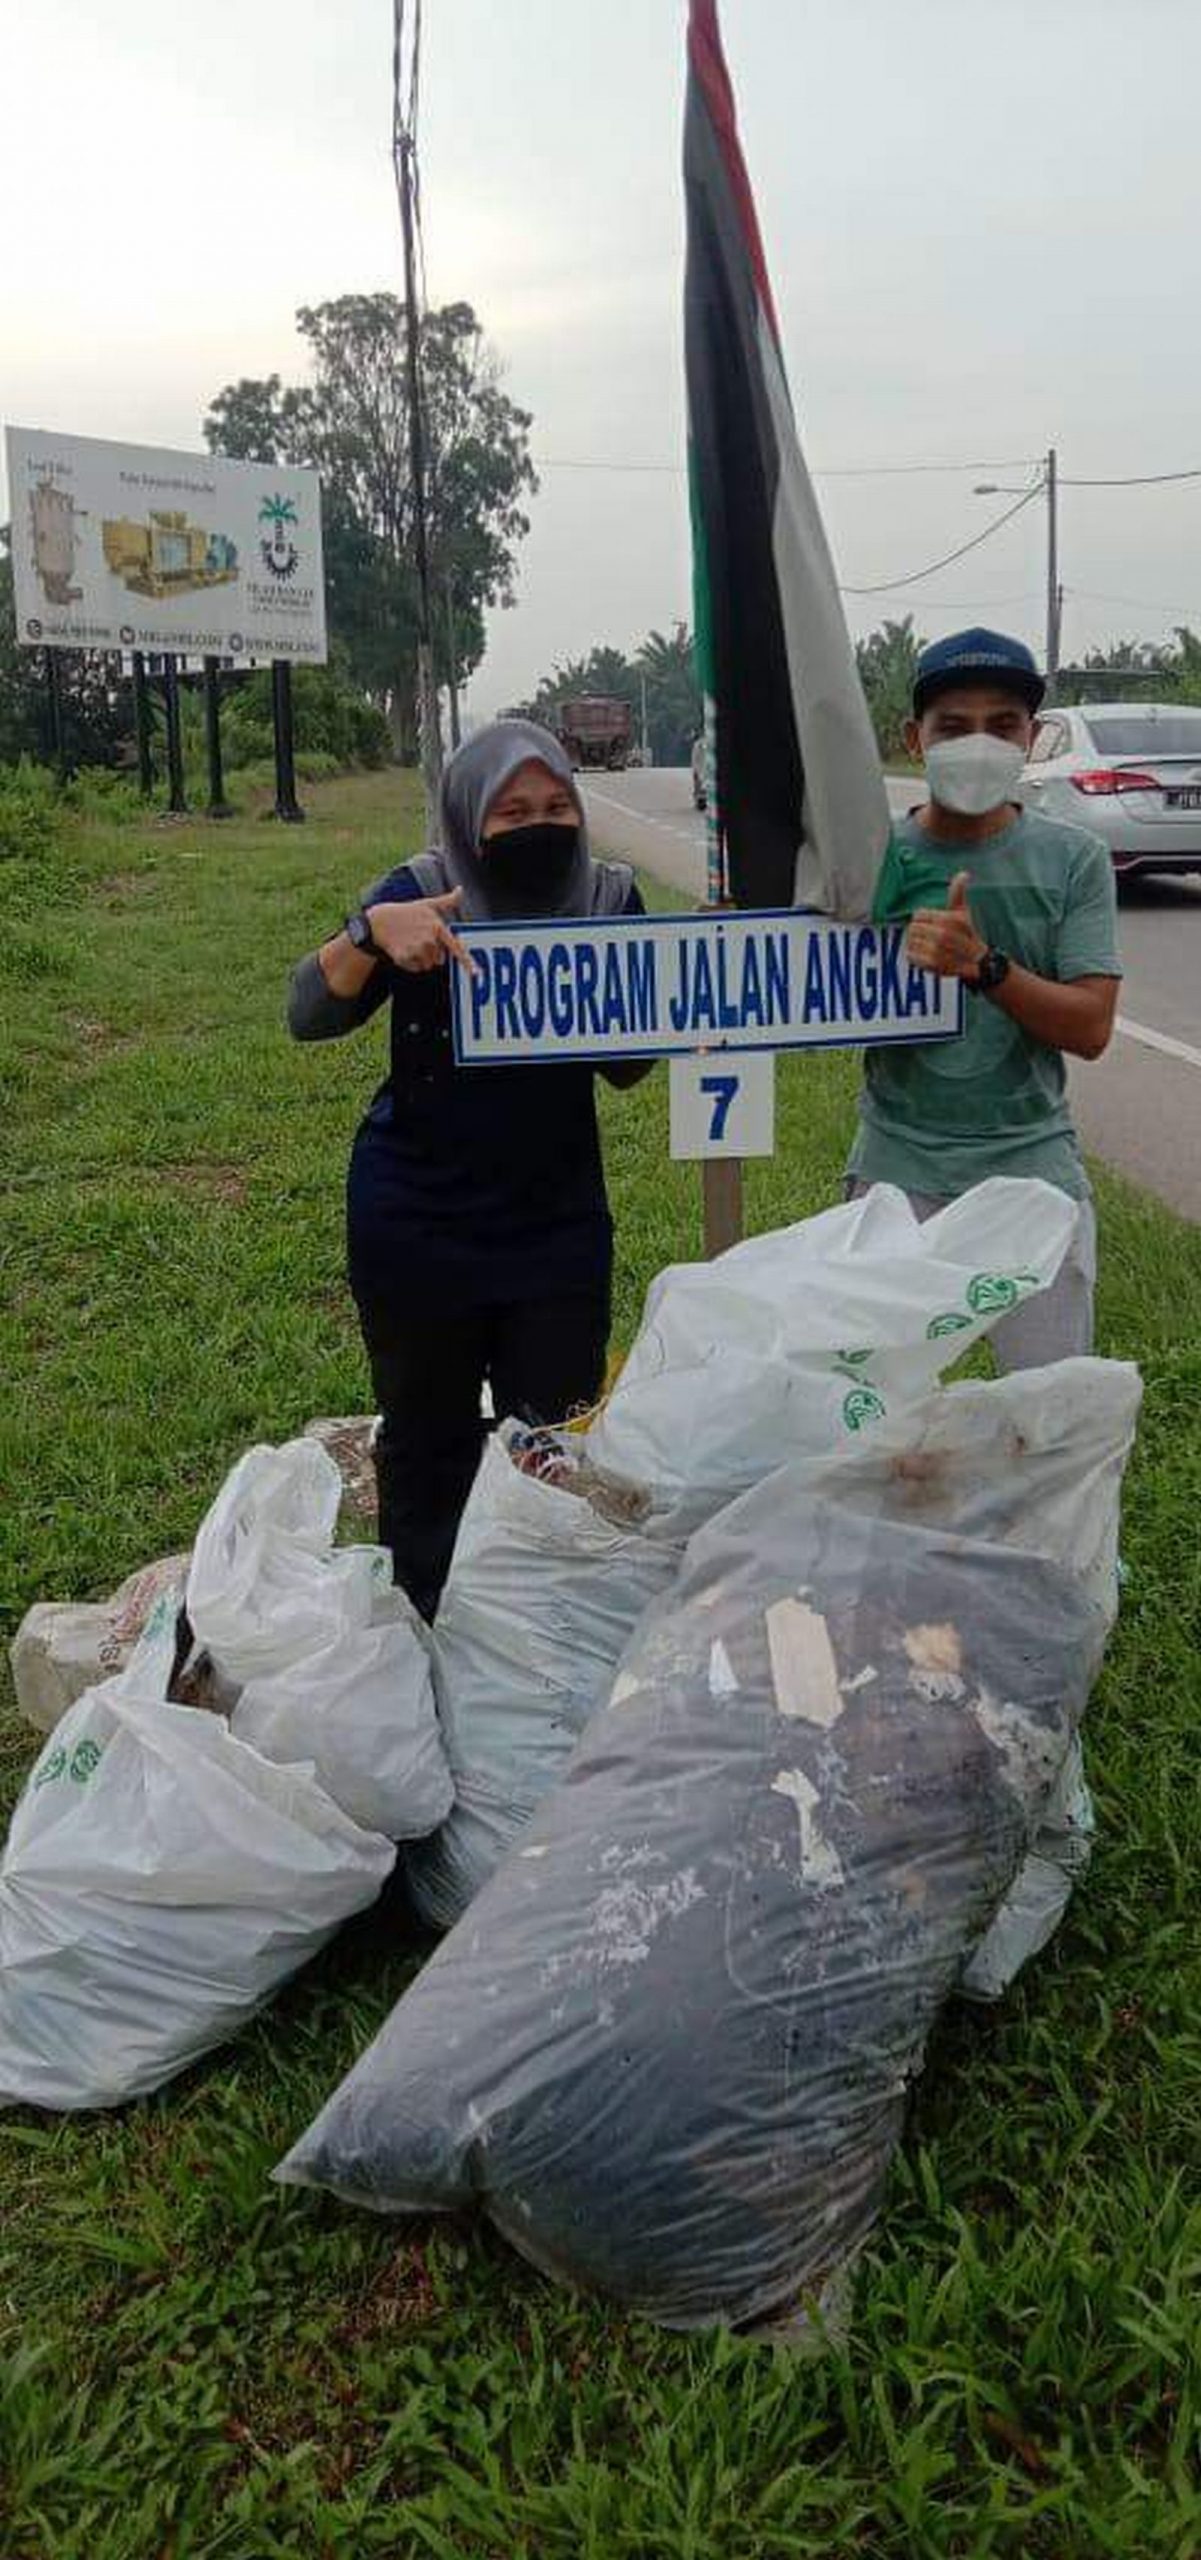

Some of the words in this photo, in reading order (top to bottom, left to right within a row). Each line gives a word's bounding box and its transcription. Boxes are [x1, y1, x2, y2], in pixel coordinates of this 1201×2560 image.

[469, 939, 657, 1040] PROGRAM
[670, 932, 790, 1031] JALAN
[701, 1076, 739, 1141] 7
